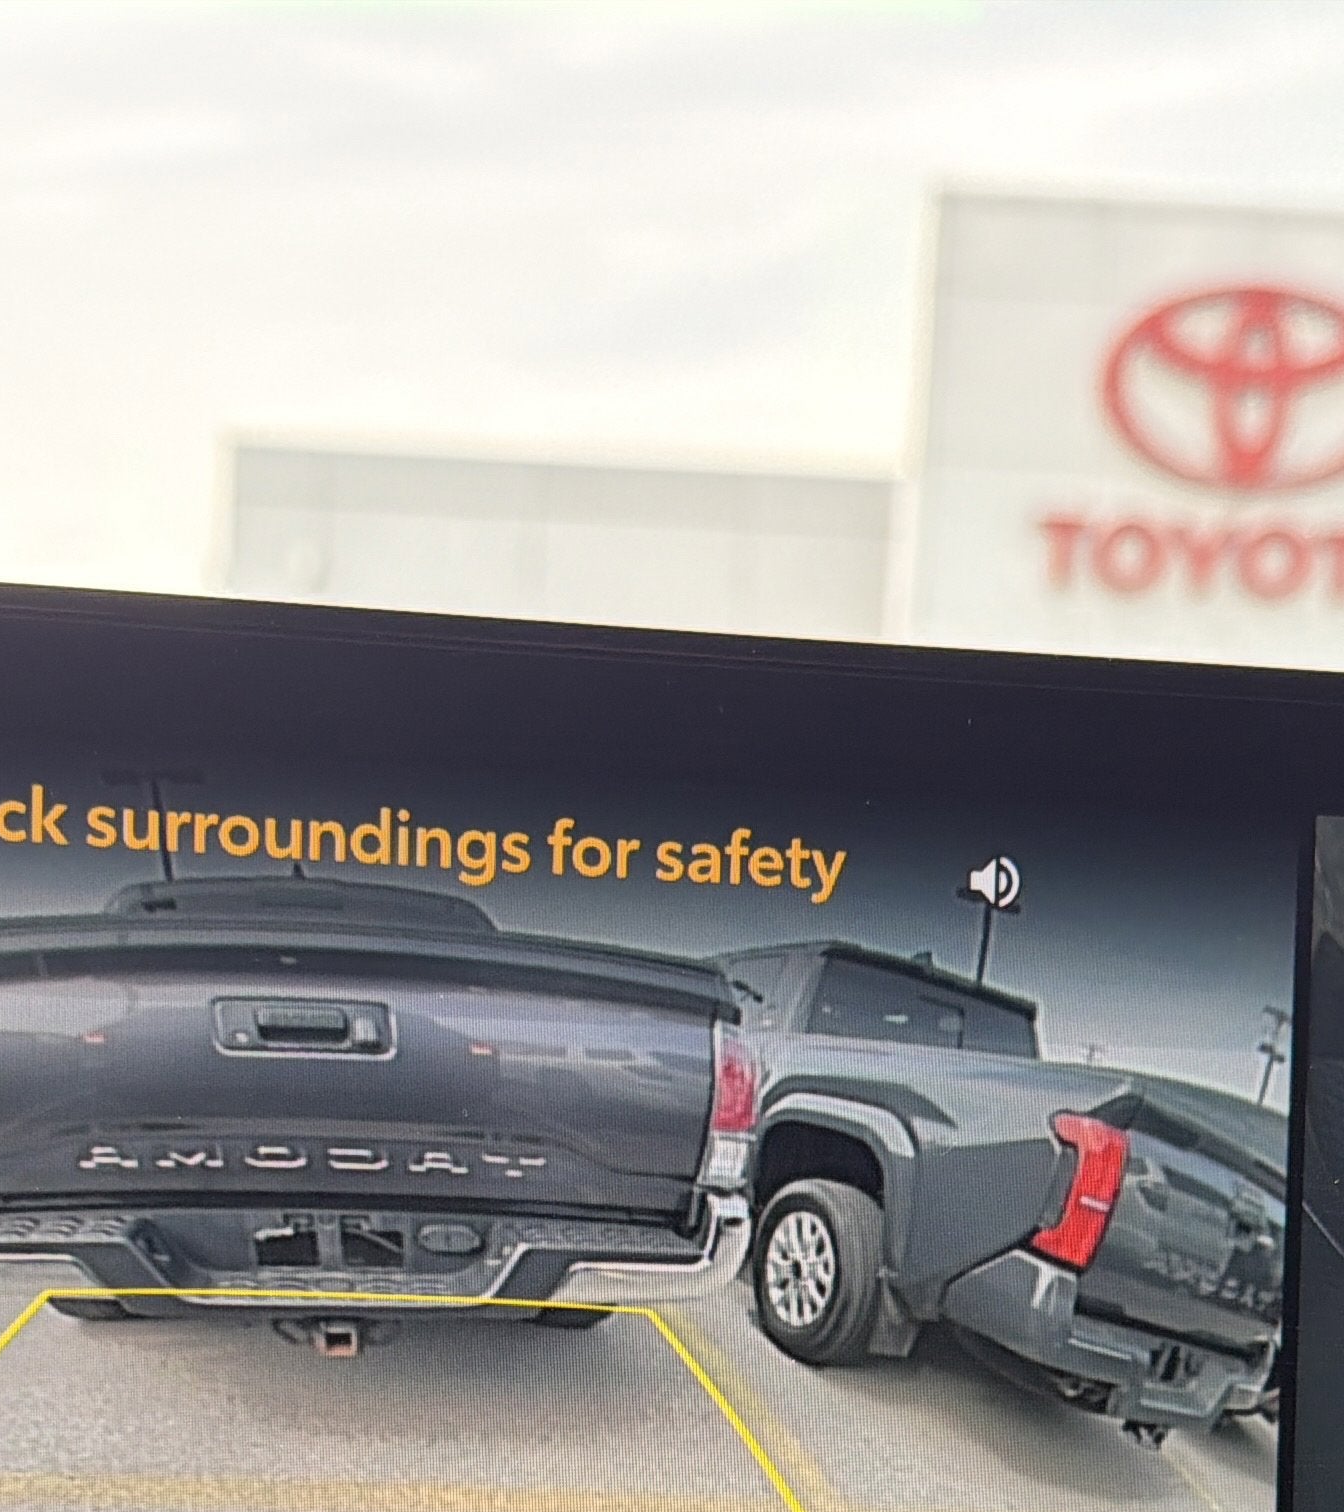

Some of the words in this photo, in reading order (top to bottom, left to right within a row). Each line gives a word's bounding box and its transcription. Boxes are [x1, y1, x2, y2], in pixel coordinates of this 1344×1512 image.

[85, 805, 531, 886] surroundings
[546, 818, 638, 880] for
[655, 827, 846, 904] safety
